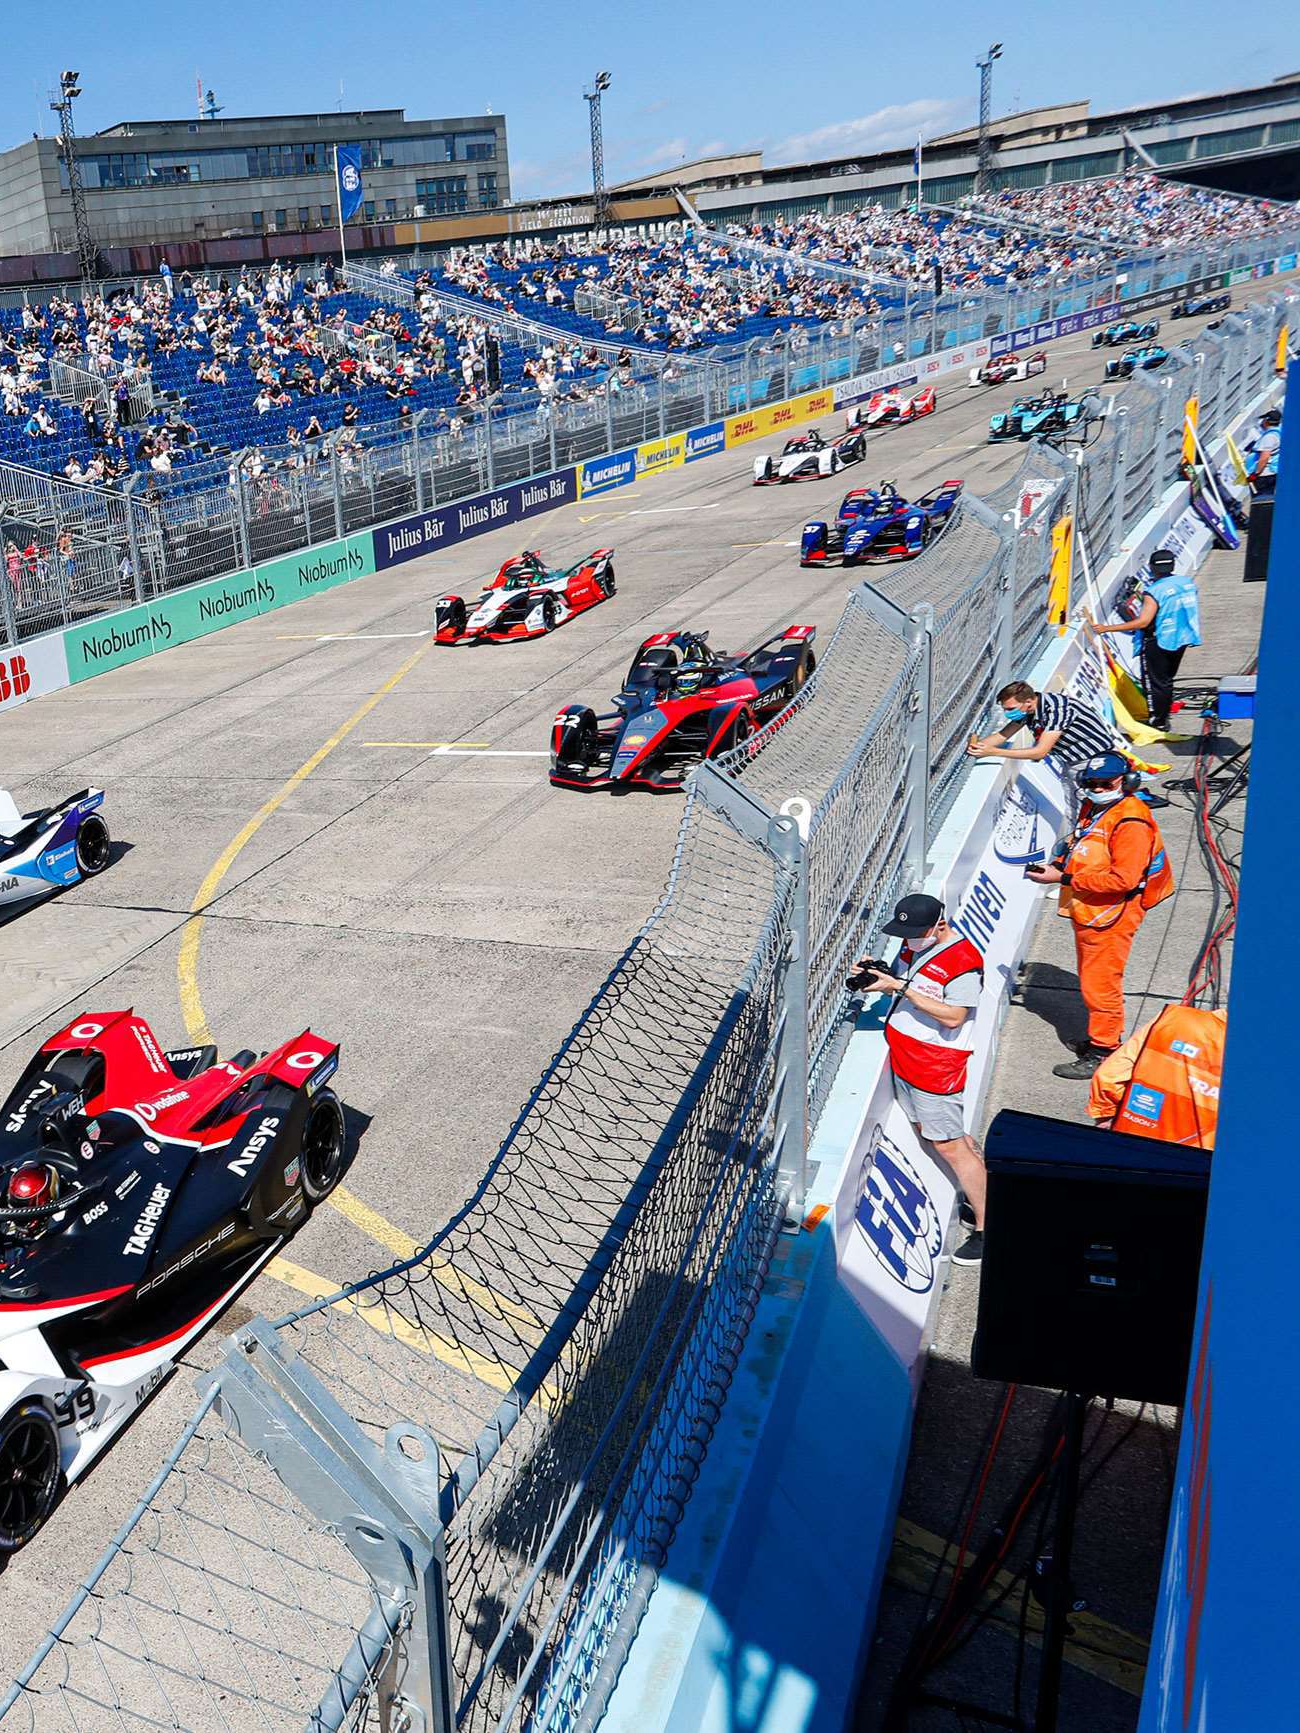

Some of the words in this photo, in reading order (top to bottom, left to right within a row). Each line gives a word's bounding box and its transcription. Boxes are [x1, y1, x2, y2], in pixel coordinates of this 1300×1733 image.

[519, 220, 542, 231] FIELD
[548, 215, 590, 228] ELEVATION
[554, 207, 573, 218] FEET
[557, 219, 694, 254] TEMPELHOF
[771, 408, 796, 425] DHL
[806, 397, 829, 414] DHL
[693, 430, 725, 450] MICHELIN
[731, 420, 758, 439] DHL
[646, 446, 681, 465] MICHELIN
[592, 461, 632, 483] MICHELIN
[520, 486, 548, 512] Julius
[549, 479, 567, 498] Bär
[458, 505, 490, 534] Julius
[490, 497, 510, 519] Bär
[387, 528, 423, 559] Julius
[424, 518, 445, 542] Bär
[803, 525, 820, 534] 37
[553, 714, 582, 729] 22
[165, 1049, 203, 1062] Ansys
[61, 1094, 85, 1121] WEH
[154, 1089, 191, 1111] vodafone
[1122, 1111, 1150, 1127] SEASON
[227, 1116, 280, 1178] Ansys
[82, 1201, 109, 1225] BOSS
[855, 1148, 928, 1282] FIA
[135, 1221, 236, 1300] PORSCHE
[135, 1365, 164, 1405] Mobil
[54, 1386, 96, 1429] 99
